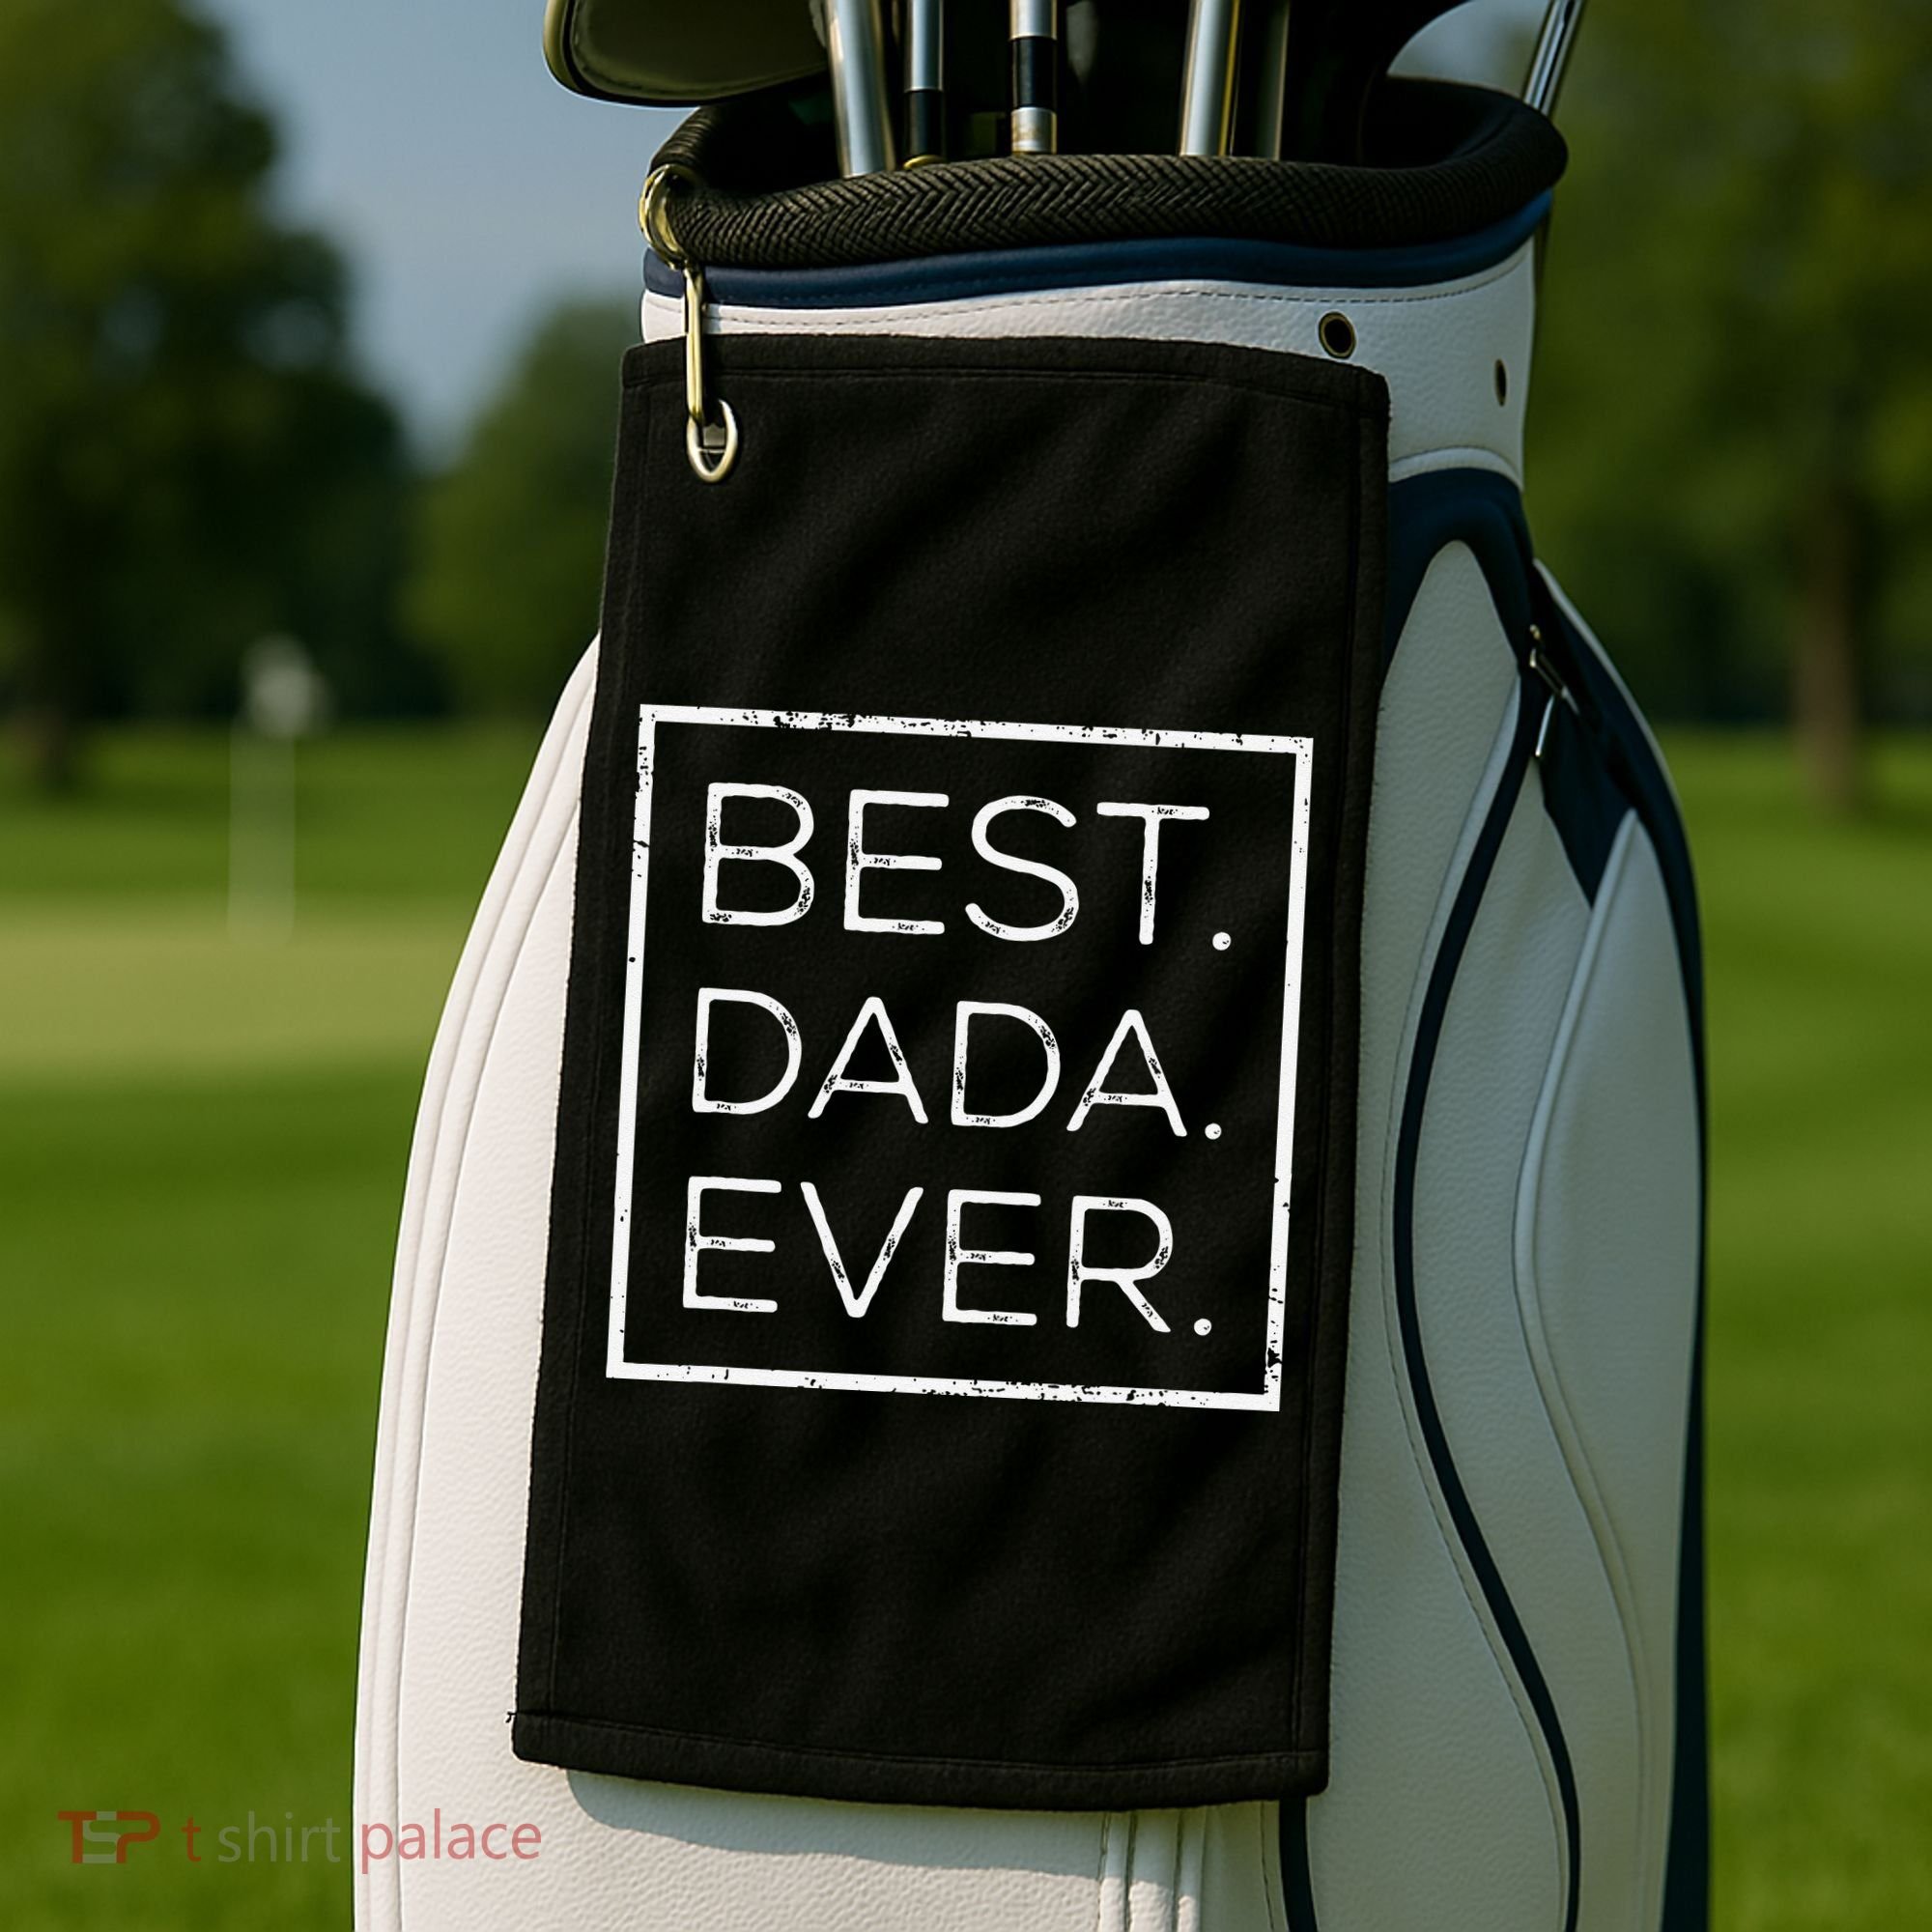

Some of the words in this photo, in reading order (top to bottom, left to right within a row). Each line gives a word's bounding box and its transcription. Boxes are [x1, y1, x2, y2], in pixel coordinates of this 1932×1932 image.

[701, 781, 1232, 952] BEST.
[692, 987, 1222, 1140] DADA.
[682, 1176, 1212, 1336] EVER.
